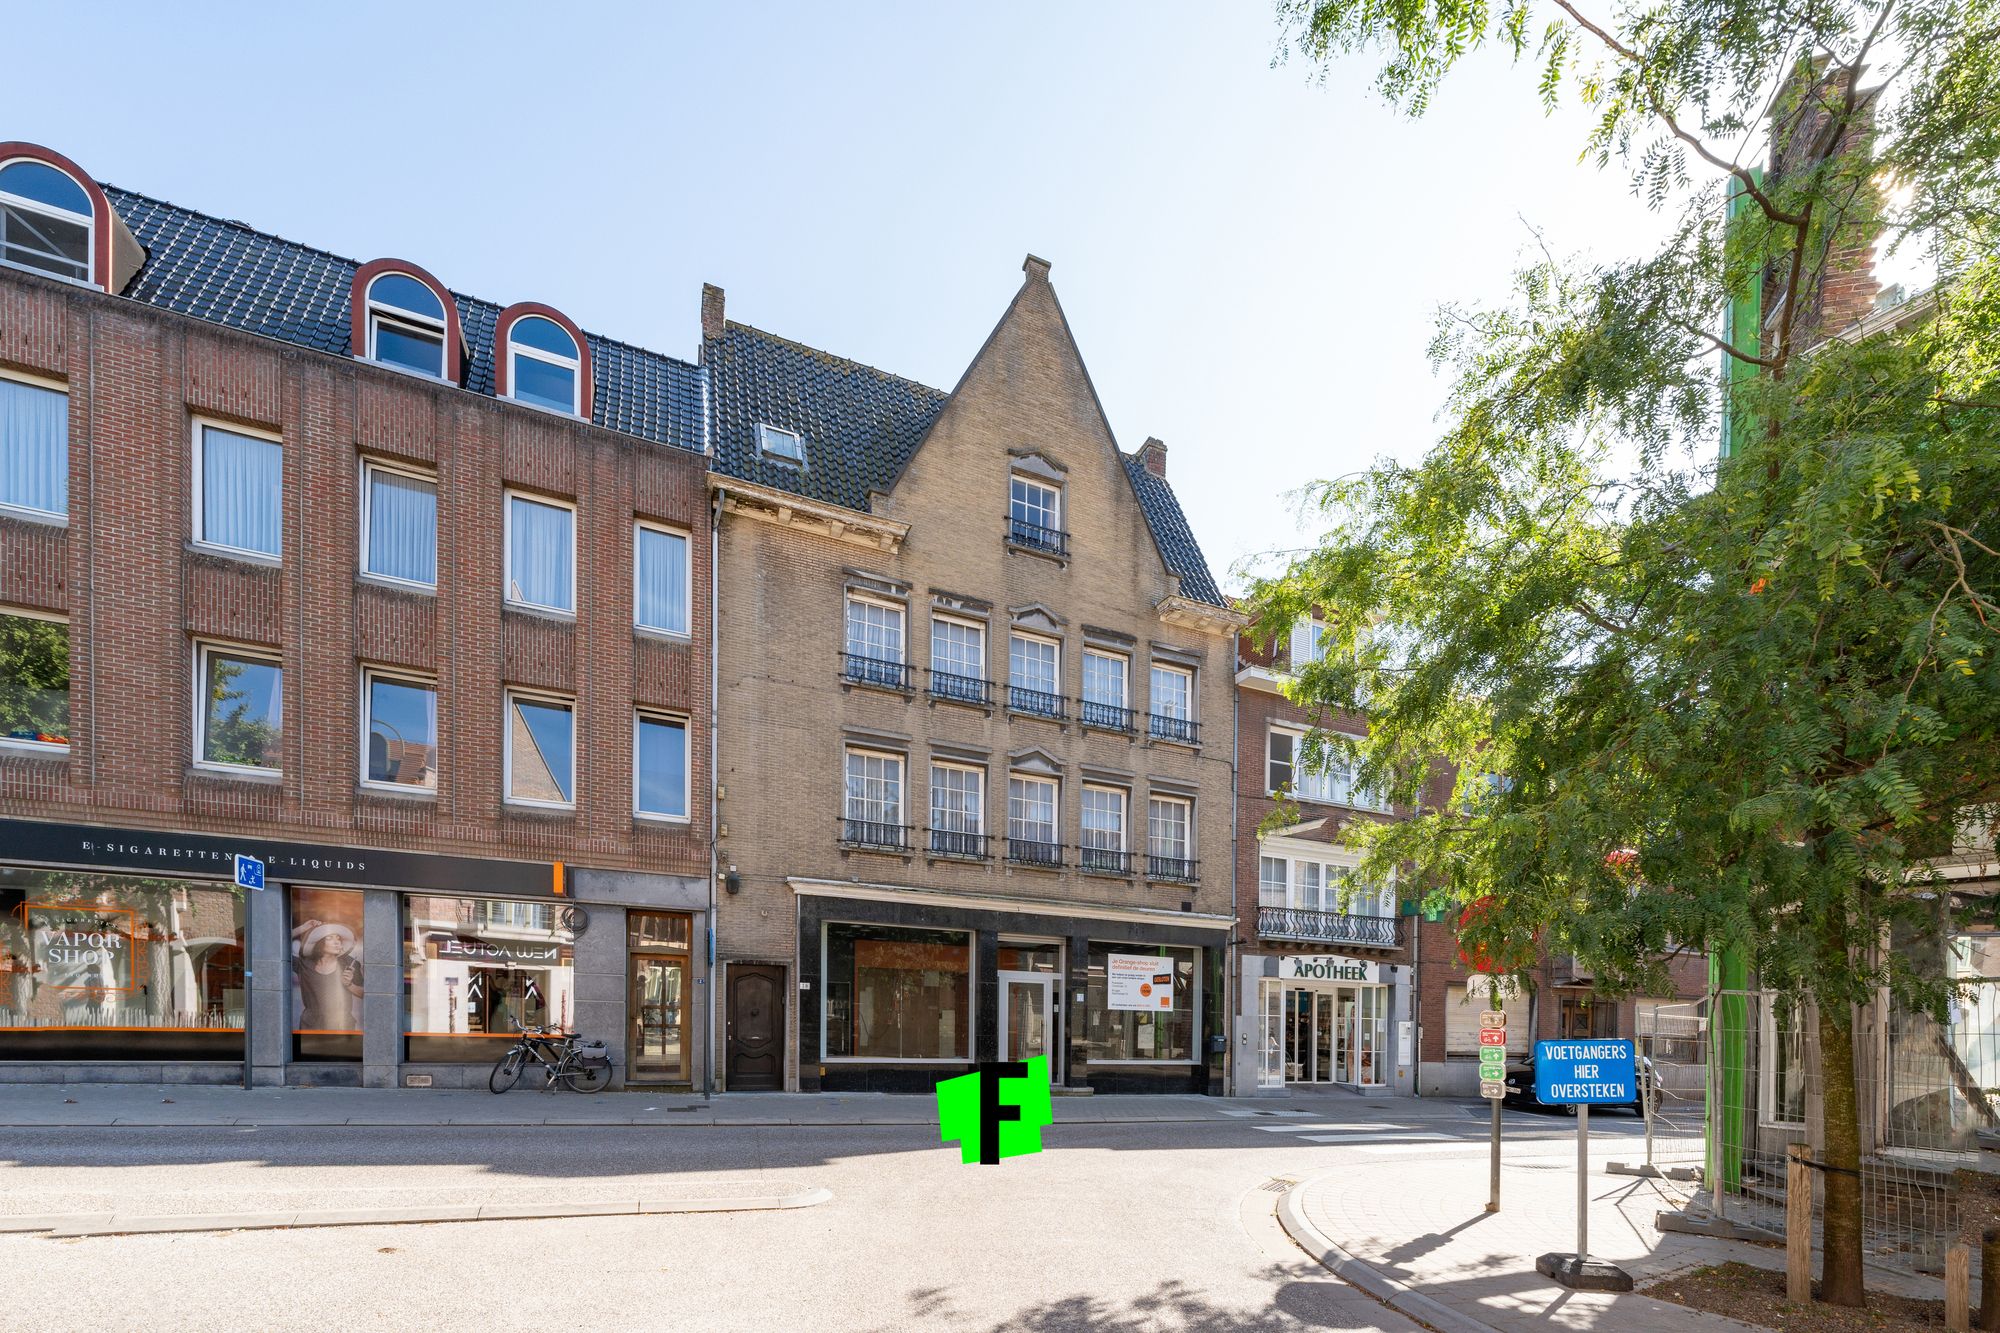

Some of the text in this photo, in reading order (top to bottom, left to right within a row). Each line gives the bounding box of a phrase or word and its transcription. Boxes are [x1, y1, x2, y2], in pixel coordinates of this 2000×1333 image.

[82, 841, 366, 871] E-SIGARETTEN E-LIQUIDS
[41, 930, 122, 948] VAPOR
[49, 948, 114, 965] SHOP
[1294, 963, 1367, 980] APOTHEEK
[1545, 1045, 1627, 1060] VOETGANGERS
[1574, 1064, 1599, 1079] HIER
[1551, 1083, 1625, 1098] OVERSTEKEN
